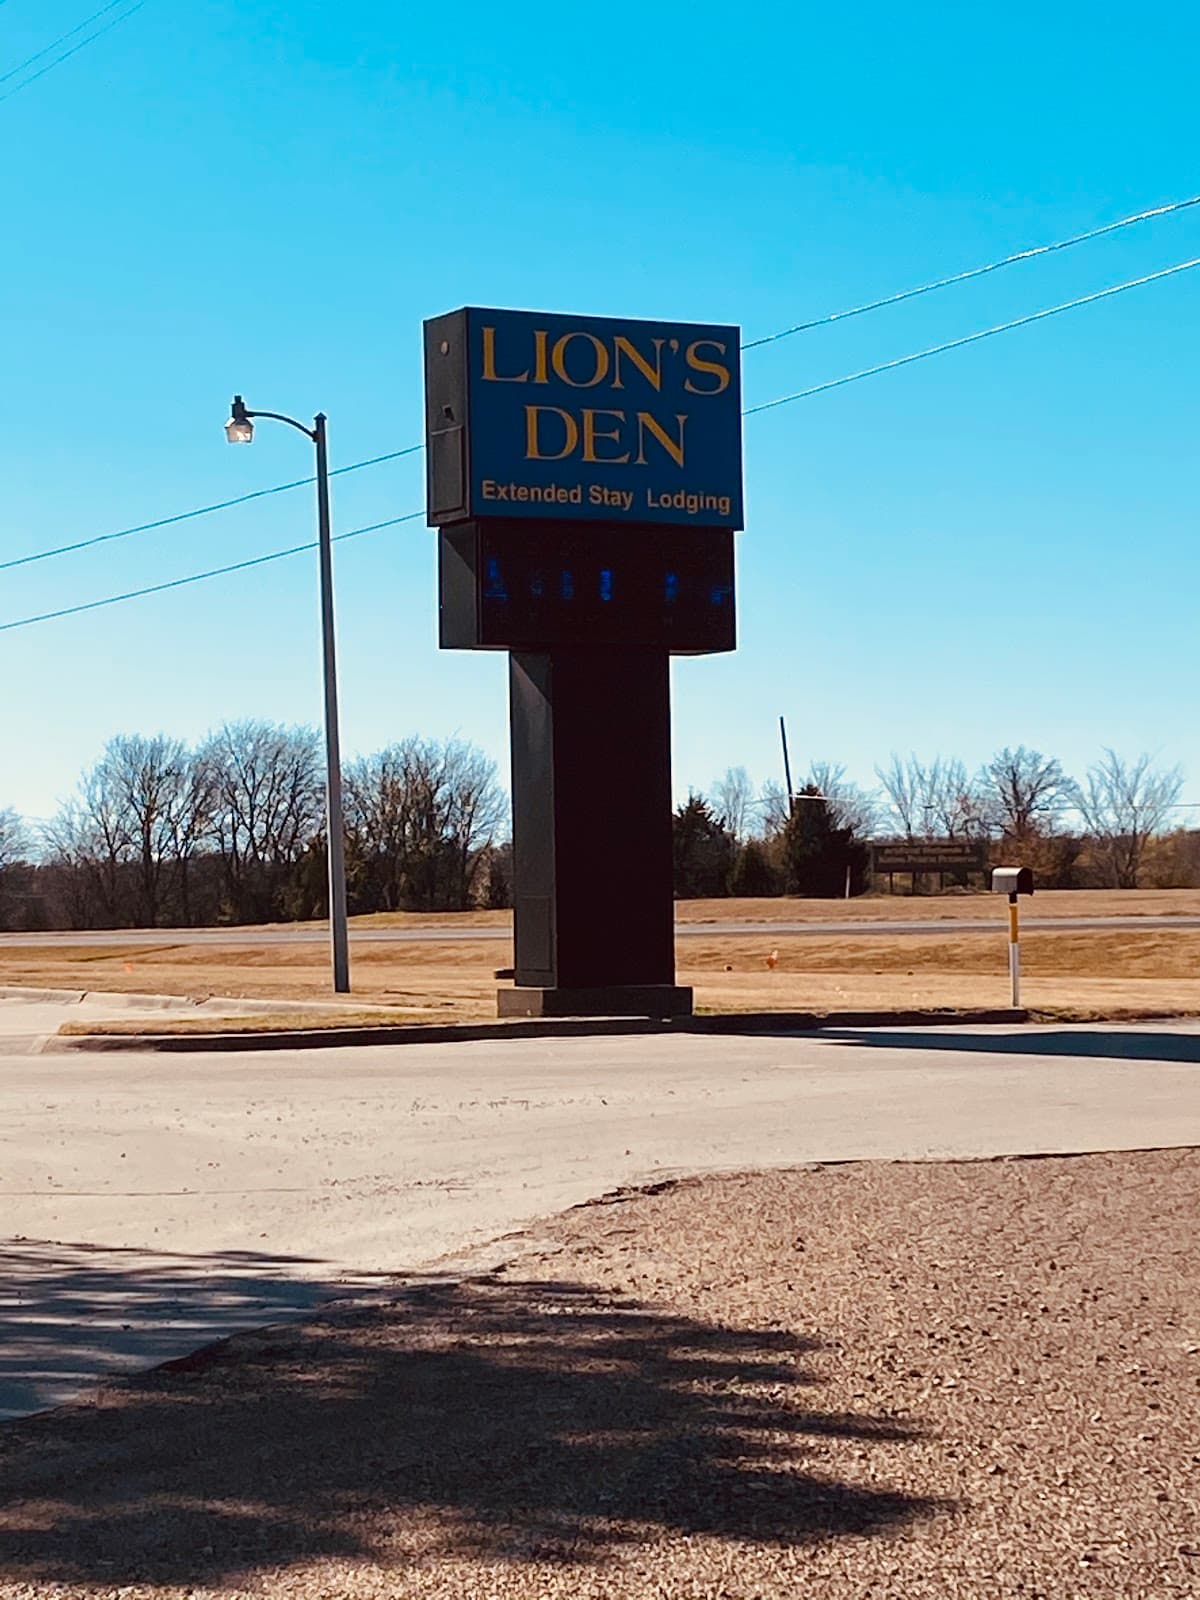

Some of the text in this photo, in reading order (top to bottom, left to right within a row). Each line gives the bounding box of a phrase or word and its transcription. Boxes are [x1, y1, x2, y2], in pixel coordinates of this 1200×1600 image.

[481, 327, 730, 395] LION'S
[524, 405, 688, 468] DEN
[481, 480, 731, 515] Extended Stay Lodging
